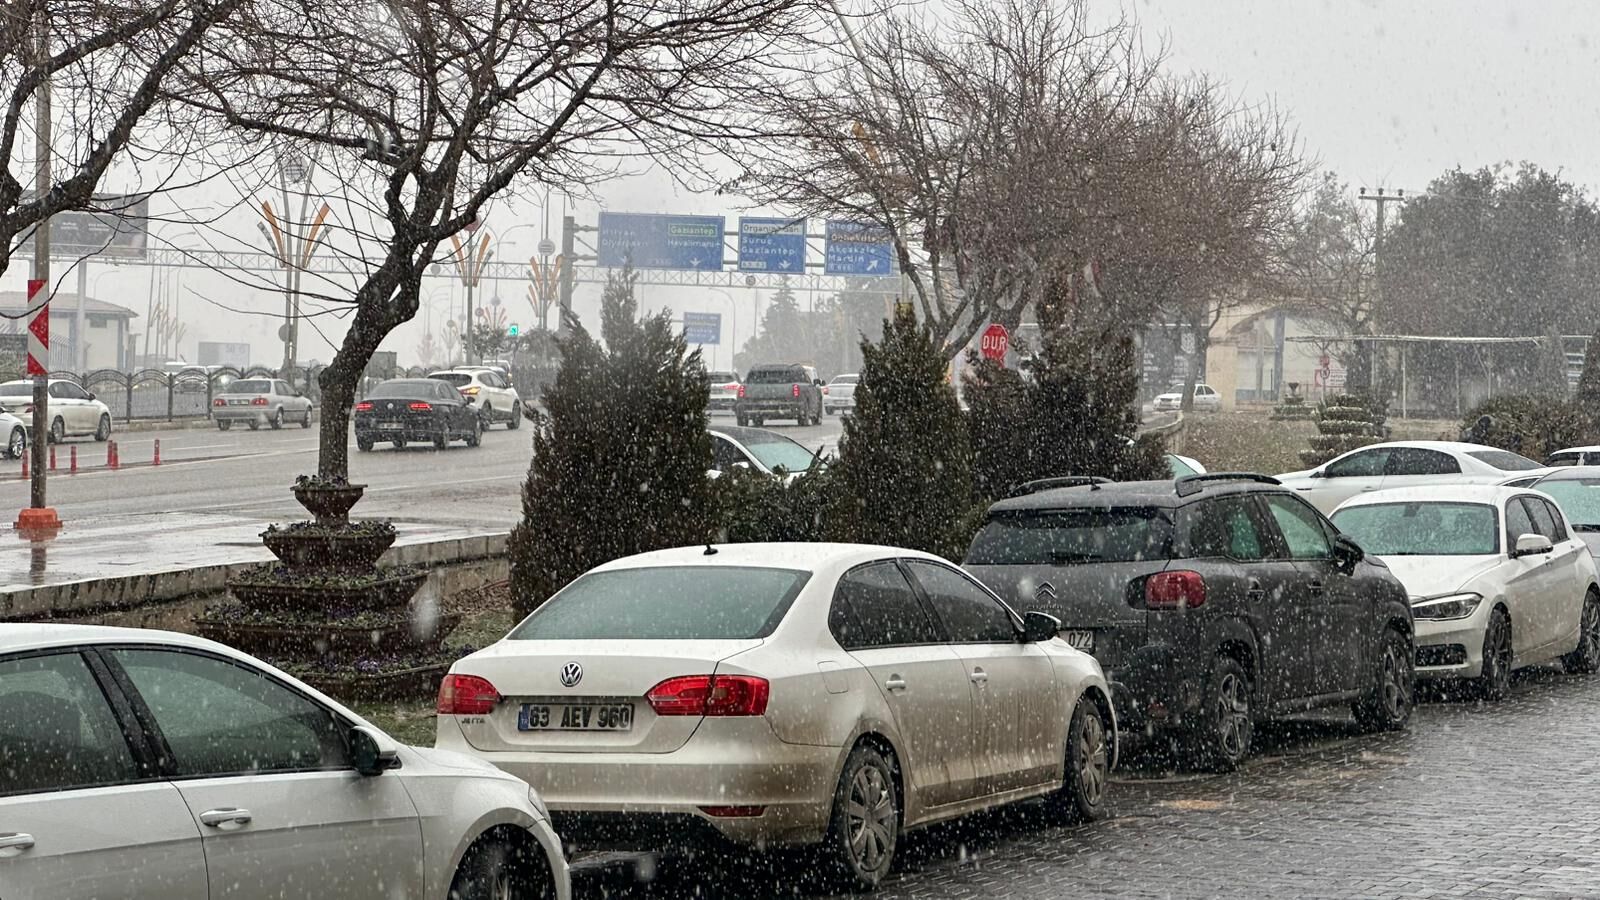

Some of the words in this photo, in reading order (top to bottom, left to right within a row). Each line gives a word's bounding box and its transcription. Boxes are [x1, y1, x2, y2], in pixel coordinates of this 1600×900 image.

[671, 225, 714, 235] Gaziantep
[742, 246, 795, 256] Gaziantep
[828, 254, 865, 262] Mardin
[983, 335, 1006, 350] DUR
[1069, 631, 1092, 647] 072
[530, 706, 550, 727] 63
[561, 706, 592, 727] AEV
[597, 707, 629, 728] 960
